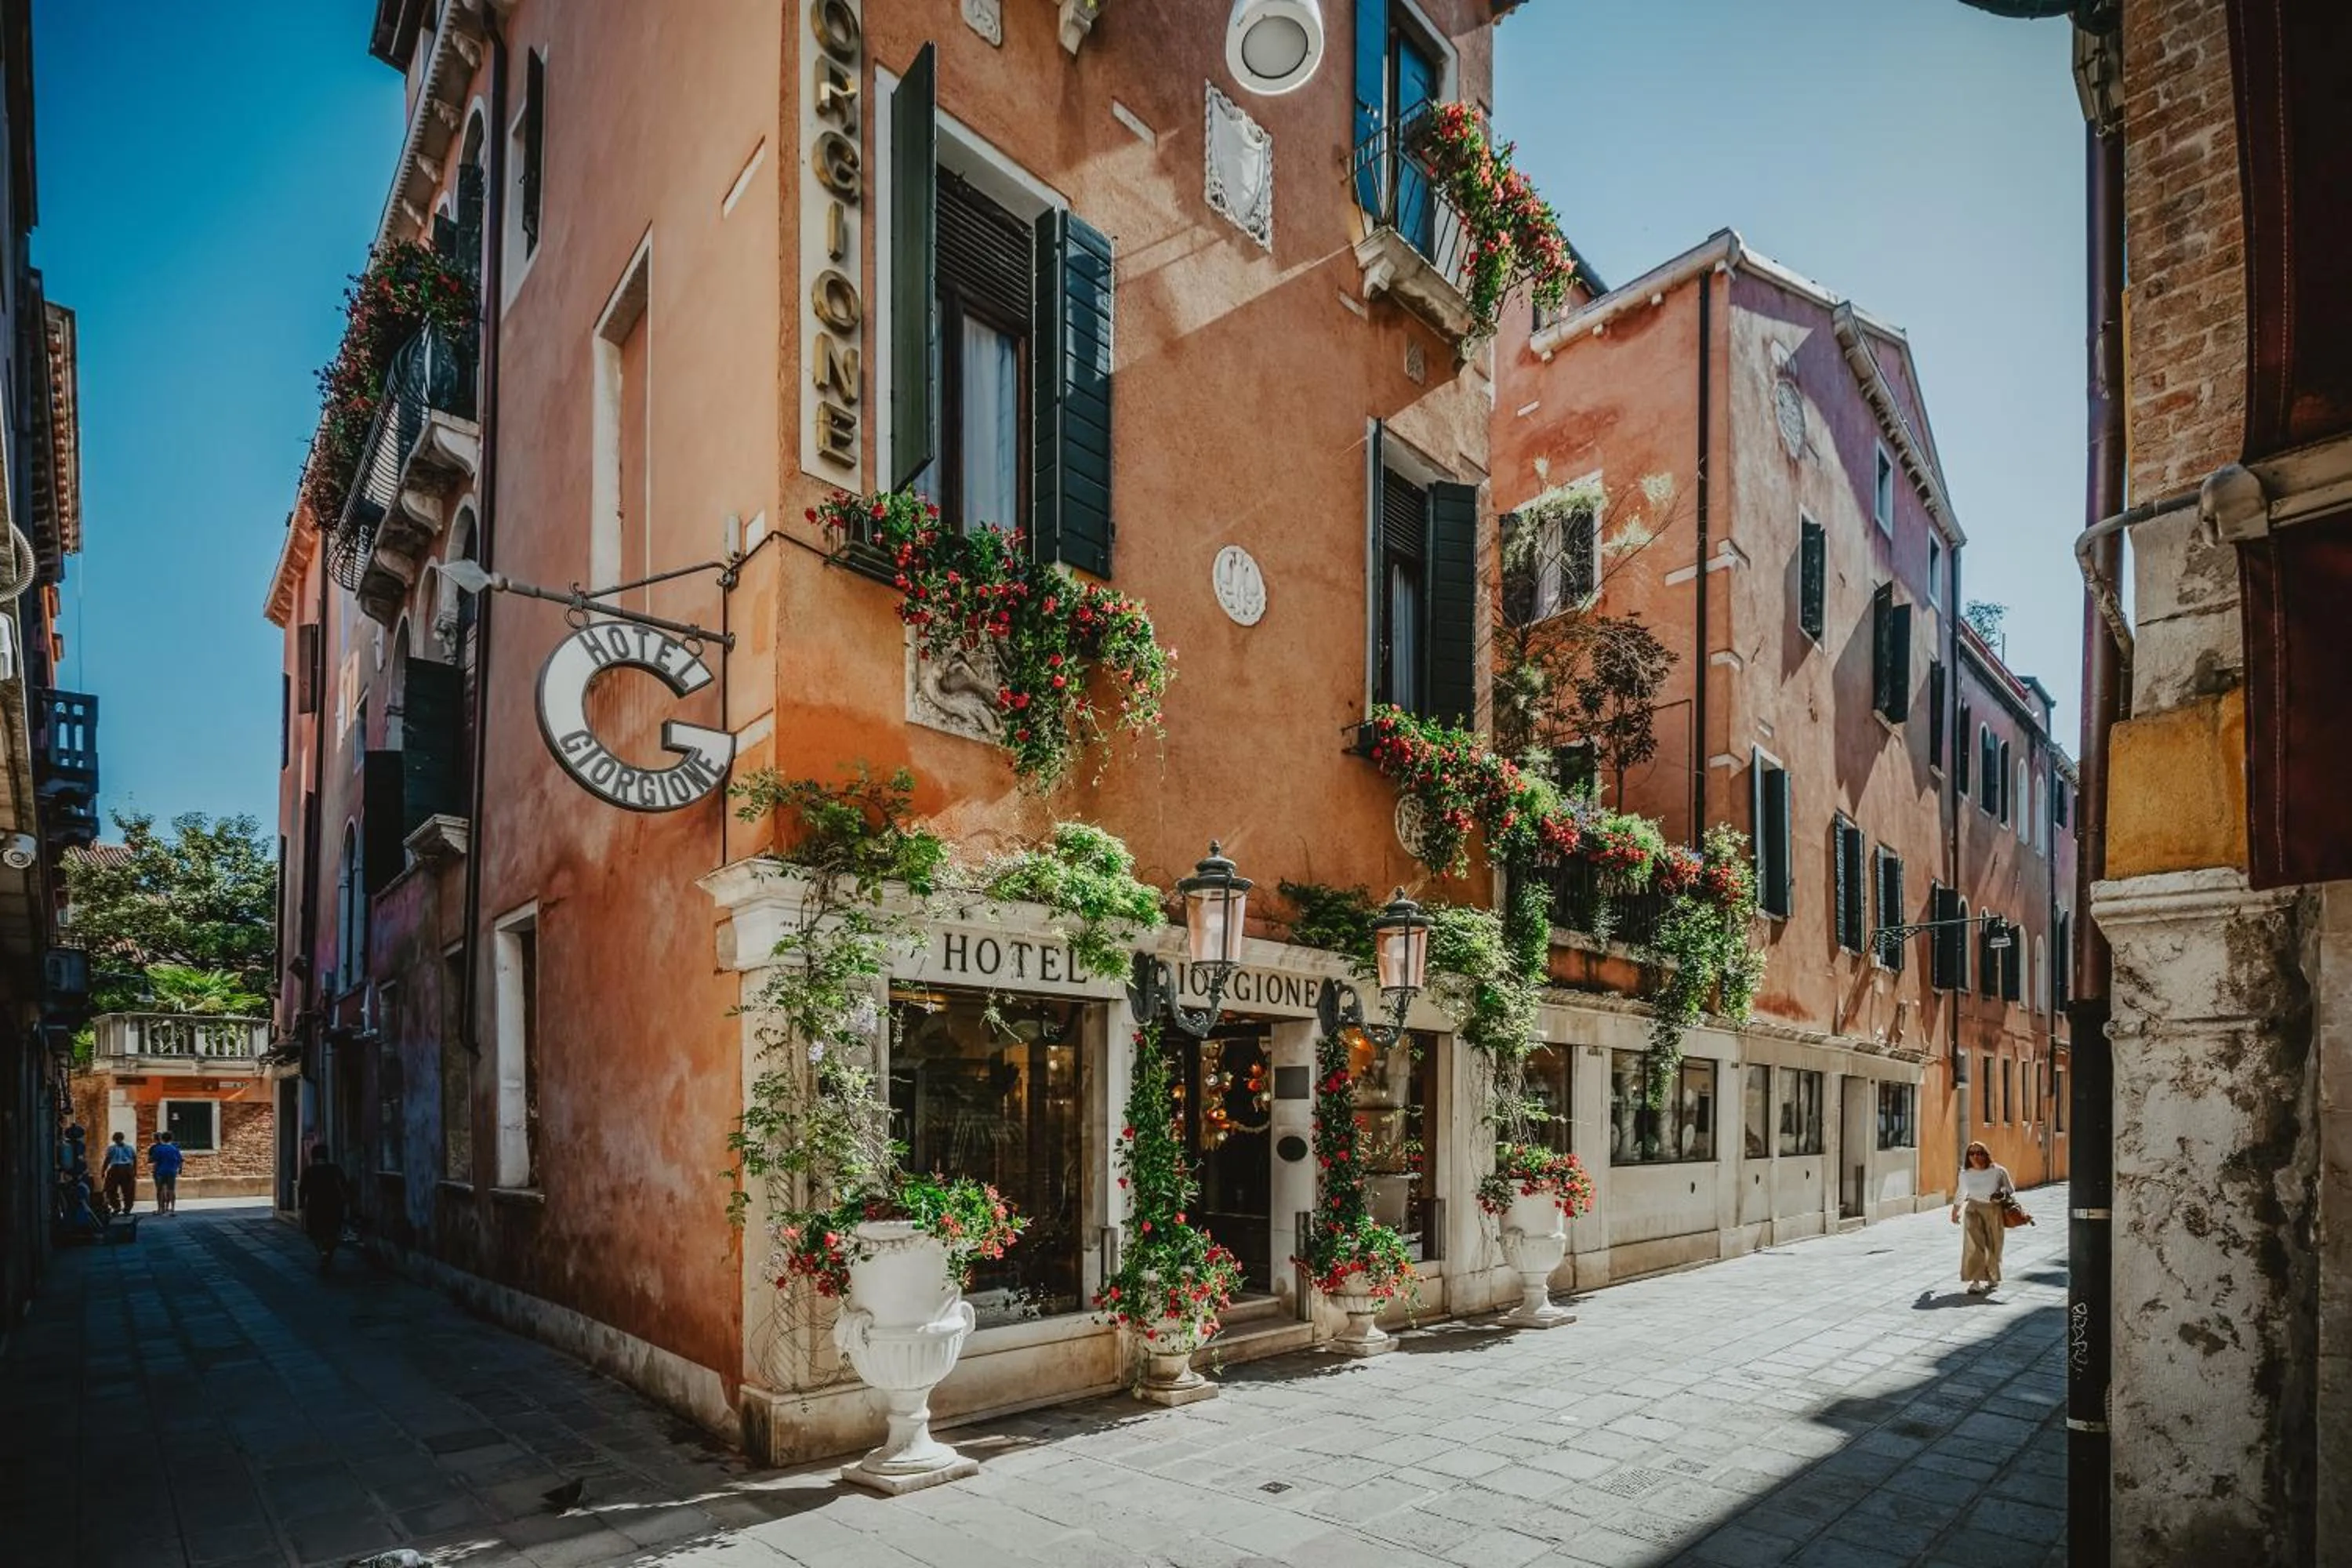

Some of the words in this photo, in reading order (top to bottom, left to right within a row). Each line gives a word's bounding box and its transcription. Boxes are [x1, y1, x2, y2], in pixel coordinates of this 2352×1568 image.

[810, 0, 861, 470] ORGIONE
[576, 626, 699, 689] HOTEL
[559, 730, 725, 805] GIORGIONE
[943, 933, 1087, 983] HOTEL
